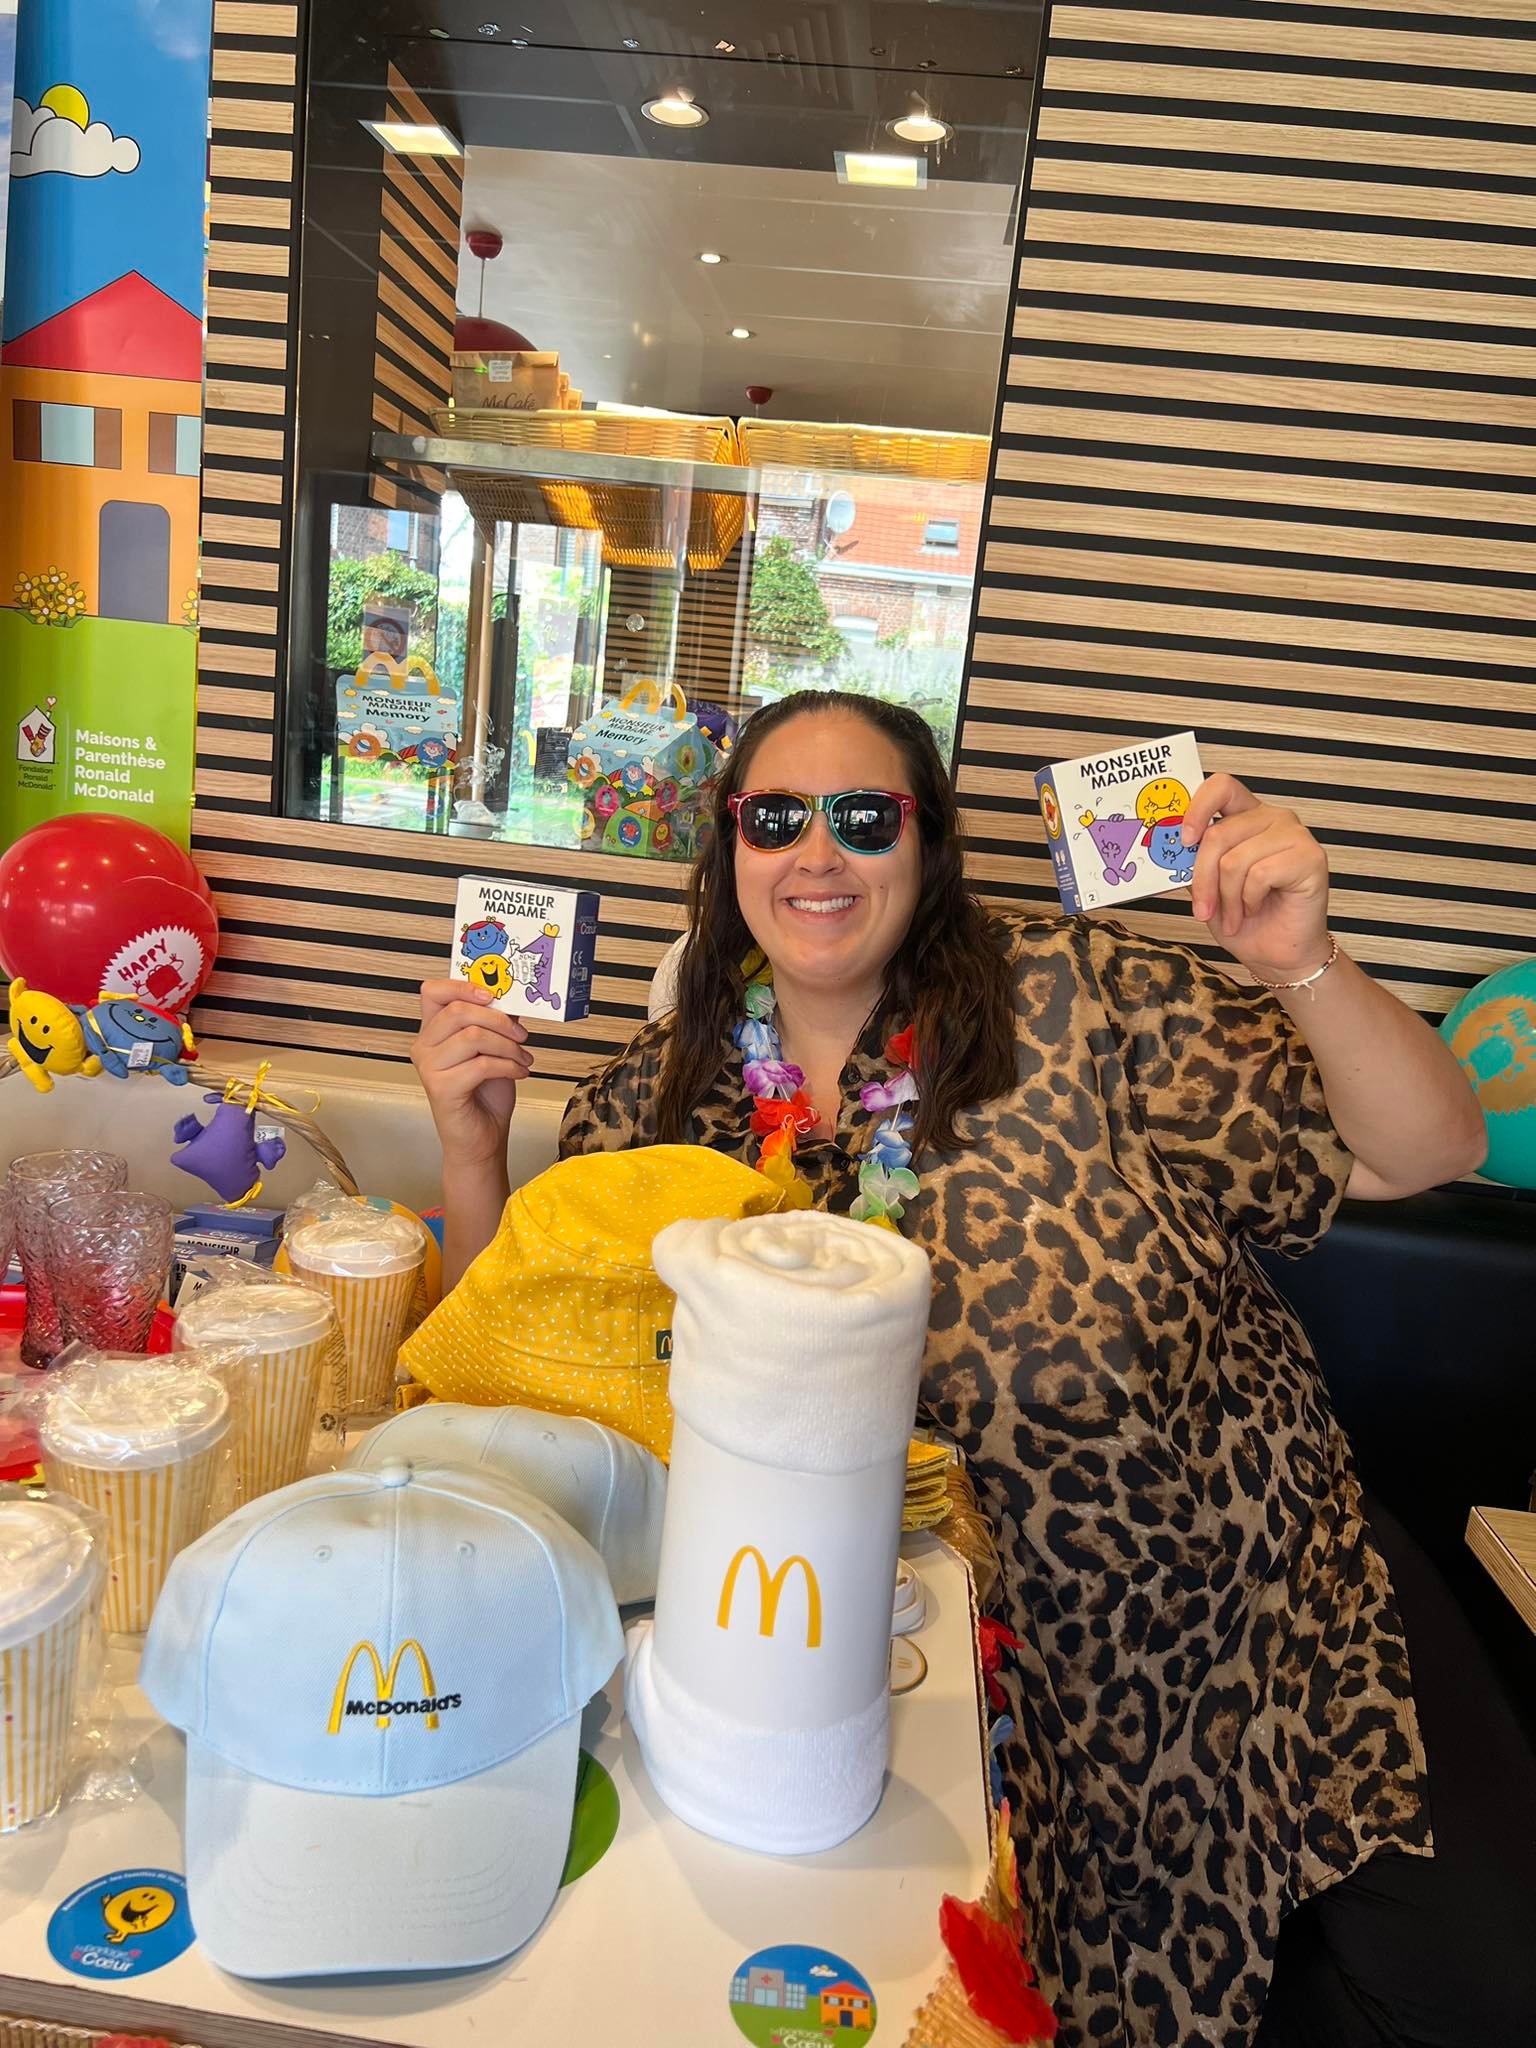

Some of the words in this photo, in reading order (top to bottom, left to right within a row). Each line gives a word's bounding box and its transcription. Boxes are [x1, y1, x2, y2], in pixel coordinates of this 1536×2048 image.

[362, 695, 432, 709] MONSIEUR
[368, 701, 427, 713] MADAME
[366, 709, 432, 723] Memory
[609, 716, 666, 732] MONSIEUR
[595, 729, 648, 746] Memory
[607, 722, 655, 736] MADAME
[76, 729, 140, 749] Maisons
[145, 736, 157, 751] &
[75, 747, 166, 769] Parenthèse
[1080, 744, 1172, 778] MONSIEUR
[18, 764, 53, 774] Fondation
[23, 773, 48, 782] Ronald
[75, 765, 131, 784] Ronald
[1091, 760, 1168, 790] MADAME
[74, 783, 155, 804] McDonald
[479, 887, 555, 909] MONSIEUR
[1088, 893, 1096, 902] 2
[484, 901, 547, 920] MADAME
[117, 938, 168, 982] HAPPY
[345, 1693, 462, 1715] McDonald's
[82, 1952, 134, 1972] Cœur
